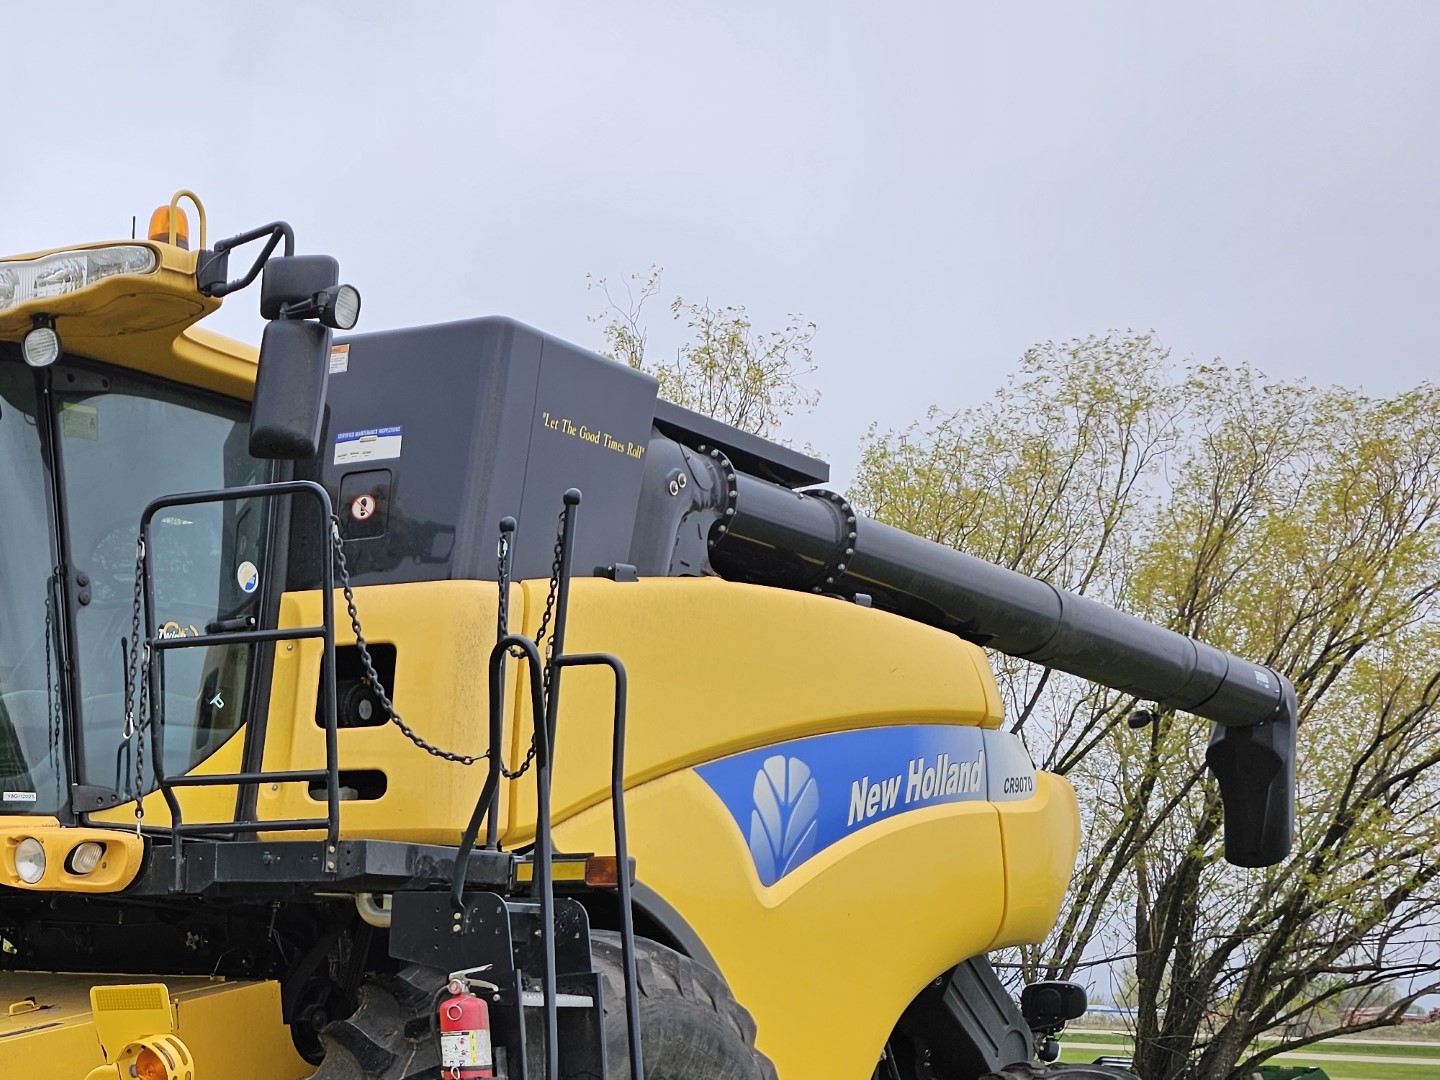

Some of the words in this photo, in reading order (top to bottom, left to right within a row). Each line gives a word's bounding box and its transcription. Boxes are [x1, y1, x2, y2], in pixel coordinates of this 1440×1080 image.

[561, 419, 577, 436] The
[579, 425, 601, 444] Good
[603, 433, 625, 453] Times
[847, 774, 902, 827] New
[905, 749, 984, 804] Holland
[1003, 776, 1033, 794] CR9070
